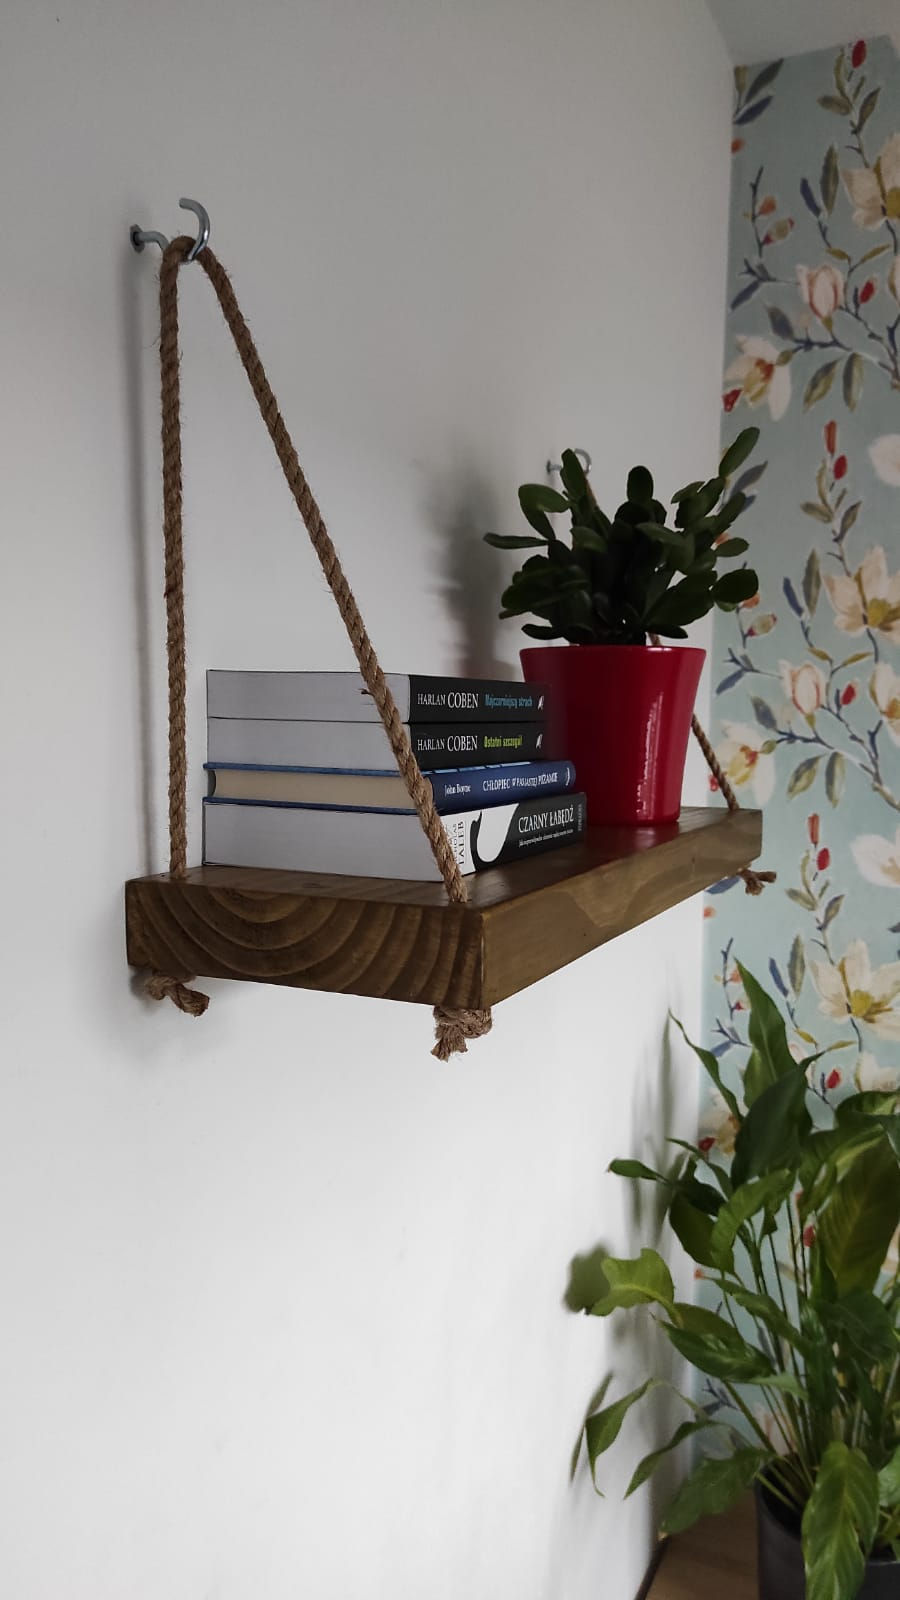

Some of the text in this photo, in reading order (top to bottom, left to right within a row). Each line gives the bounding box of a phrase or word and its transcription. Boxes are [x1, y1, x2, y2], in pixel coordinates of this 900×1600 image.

[417, 693, 446, 706] HARLAN
[447, 692, 479, 709] COBEN
[417, 738, 445, 751] HARLAN
[447, 735, 478, 751] COBEN
[484, 735, 502, 748] Ostatni
[444, 784, 456, 797] John
[456, 783, 471, 796] Boyne
[482, 778, 511, 792] CHŁOPIEC
[518, 813, 549, 833] CZARNY
[549, 804, 574, 827] ŁABĘDŹ
